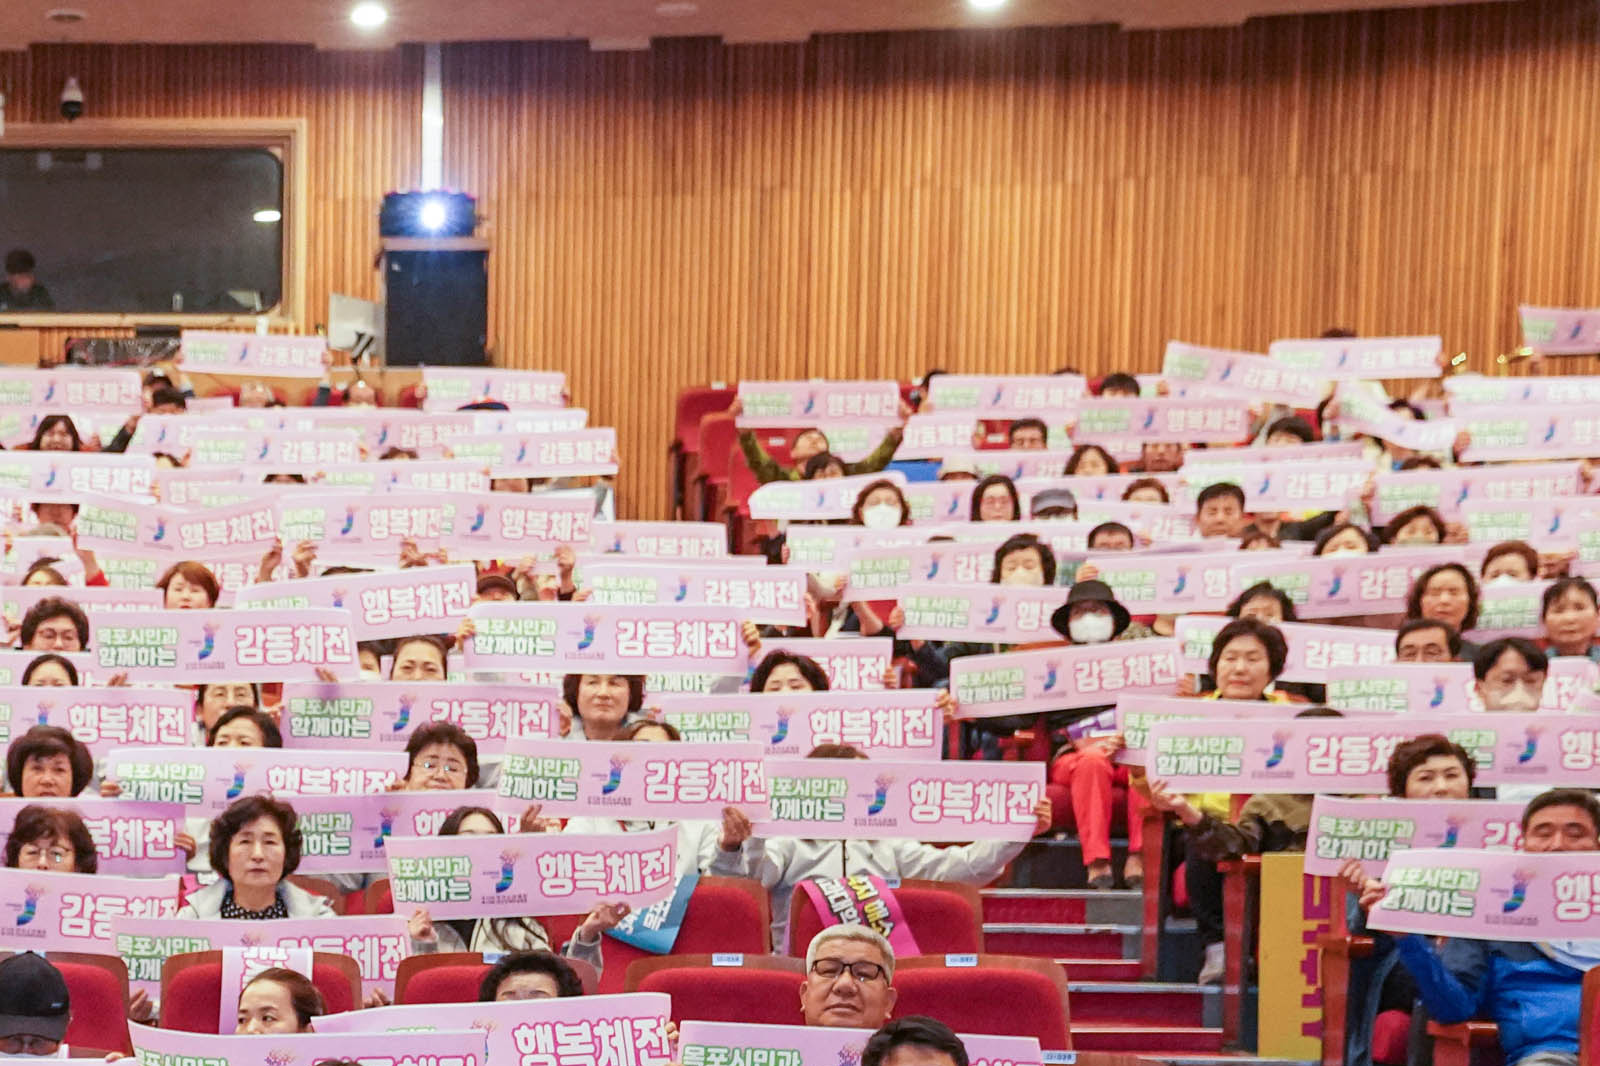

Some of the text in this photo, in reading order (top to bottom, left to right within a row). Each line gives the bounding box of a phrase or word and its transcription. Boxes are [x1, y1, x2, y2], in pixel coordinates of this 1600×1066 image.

[358, 582, 472, 625] 행복체전
[97, 646, 178, 668] 함께하는
[233, 622, 354, 666] 감동체전
[613, 618, 738, 660] 감동체전
[1073, 649, 1179, 694] 감동체전
[67, 703, 187, 746] 행복체전
[290, 715, 372, 741] 함께하는
[806, 704, 937, 748] 행복체전
[643, 758, 768, 804] 감동체전
[1156, 754, 1244, 777] 함께하는
[907, 778, 1040, 825] 행복체전
[534, 843, 675, 898] 행복체전
